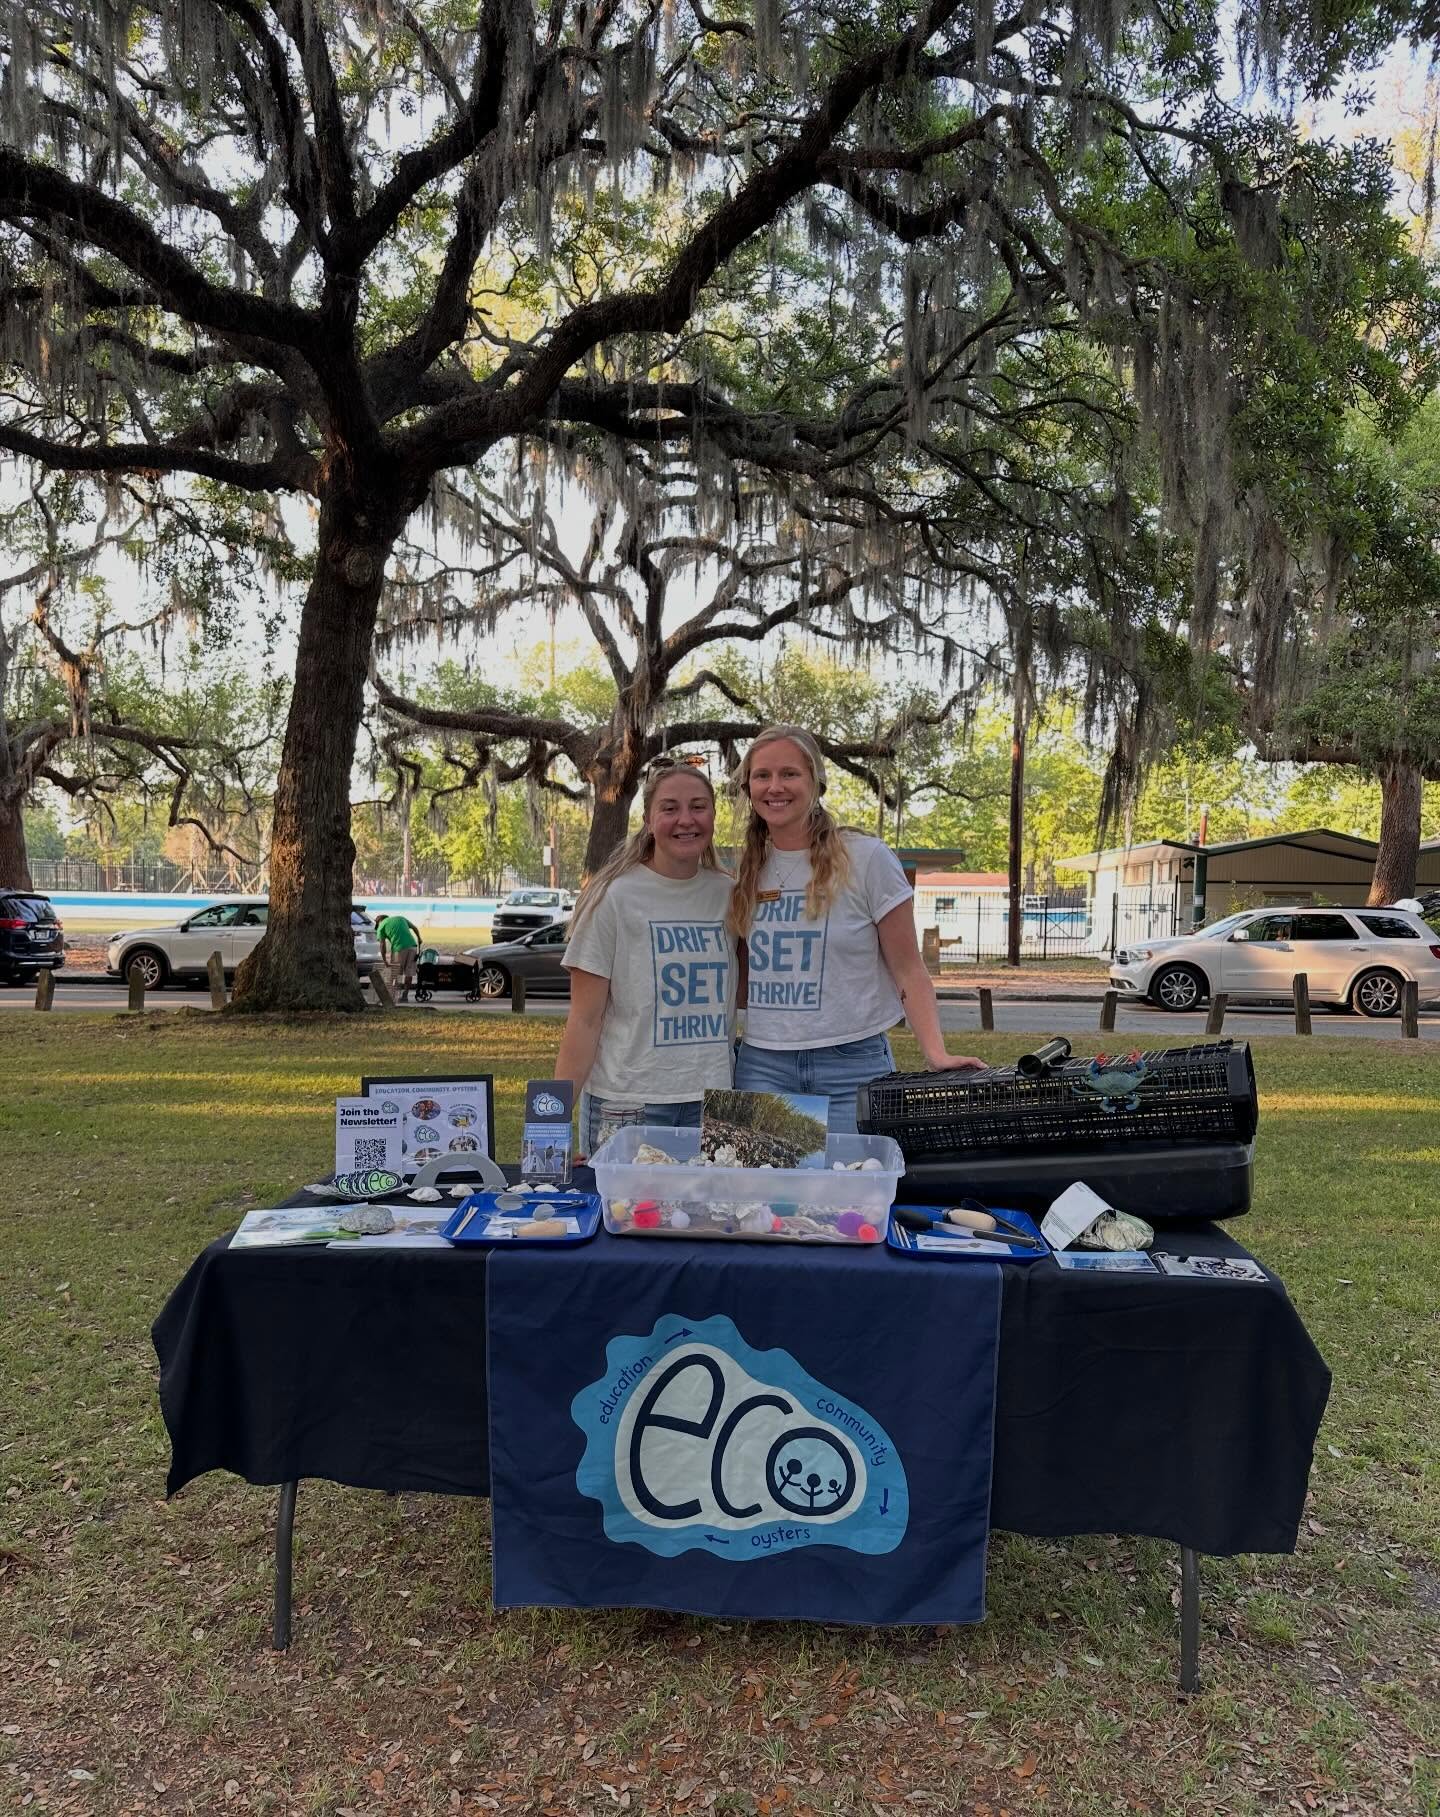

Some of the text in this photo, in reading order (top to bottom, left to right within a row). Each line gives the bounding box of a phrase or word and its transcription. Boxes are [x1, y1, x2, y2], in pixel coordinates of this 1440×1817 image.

[752, 896, 825, 922] DRIF
[656, 926, 724, 953] DRIFT
[749, 930, 821, 972] SET
[661, 962, 729, 1007] SET
[749, 982, 817, 1005] THRIVE
[340, 1108, 380, 1116] Join the
[340, 1117, 397, 1126] Newsletter!
[370, 1172, 396, 1191] eco
[600, 1356, 652, 1424] education
[629, 1353, 856, 1520] eco
[816, 1398, 888, 1466] community
[751, 1526, 811, 1549] oysters
